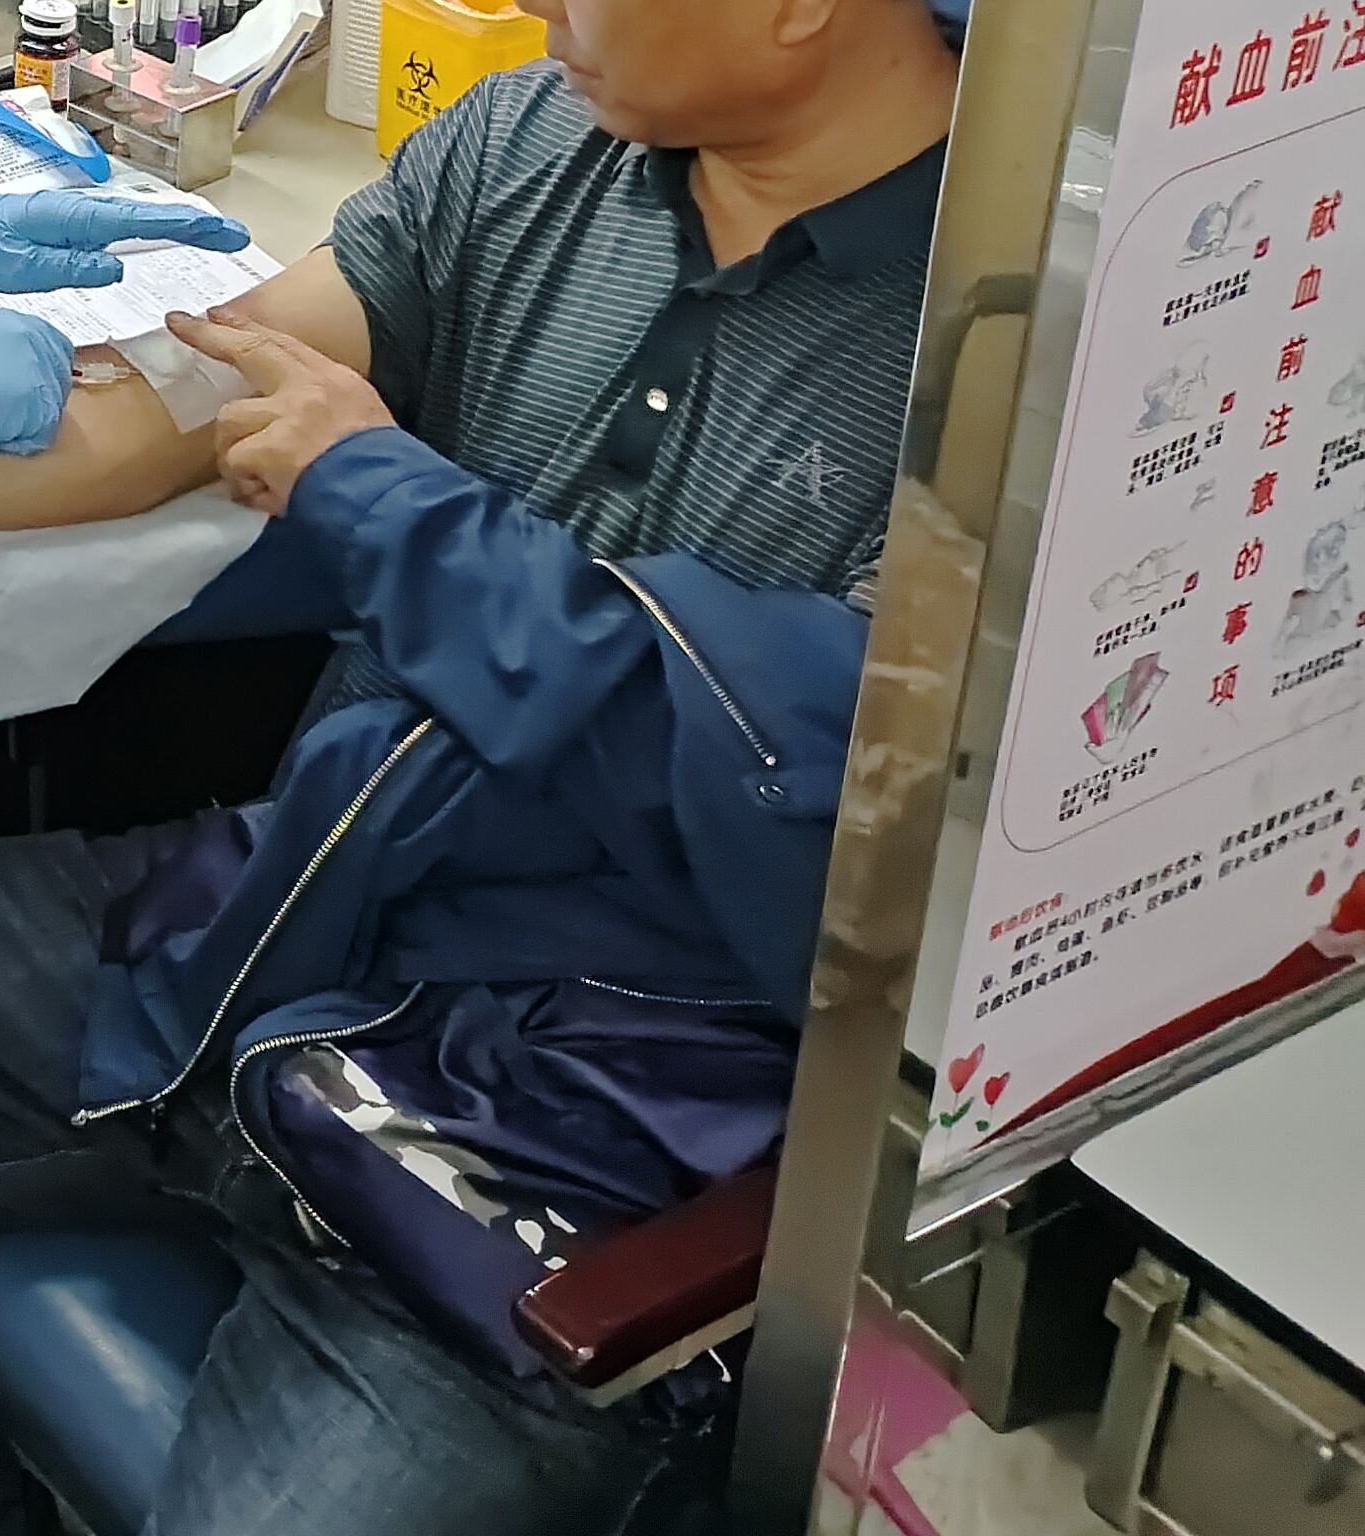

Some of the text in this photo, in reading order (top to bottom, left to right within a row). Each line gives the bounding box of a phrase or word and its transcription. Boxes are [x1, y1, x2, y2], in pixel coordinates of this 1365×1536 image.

[1207, 189, 1344, 707] 献血前注意的事项
